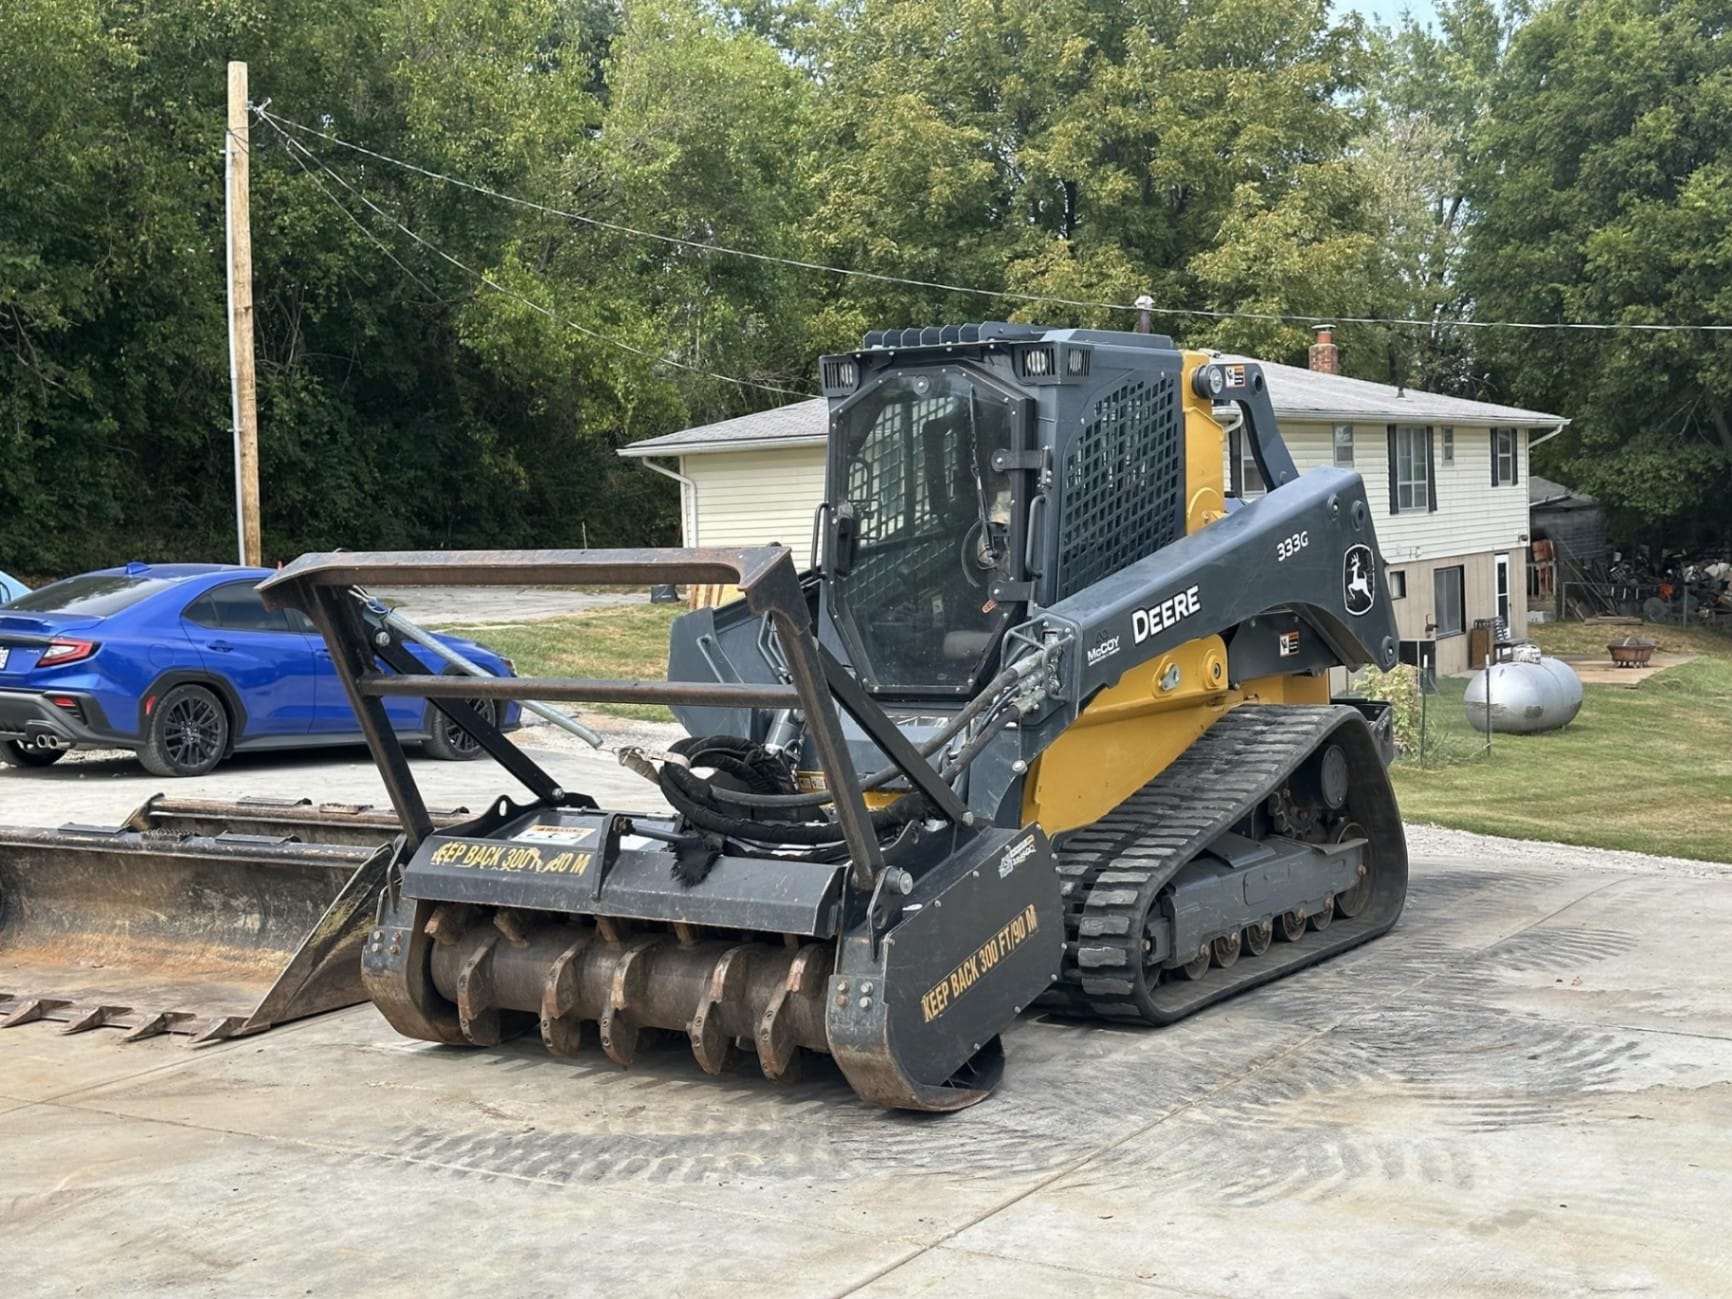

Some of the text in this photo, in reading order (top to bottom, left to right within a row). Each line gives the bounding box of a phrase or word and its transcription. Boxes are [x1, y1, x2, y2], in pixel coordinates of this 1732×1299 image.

[1276, 530, 1309, 562] 333G
[1131, 585, 1201, 645] DEERE
[1087, 635, 1120, 662] McCOY
[463, 845, 506, 867] BACK
[502, 847, 531, 870] 300
[570, 853, 592, 876] M
[921, 904, 1038, 1023] KEEP BACK 300 FT/90 M
